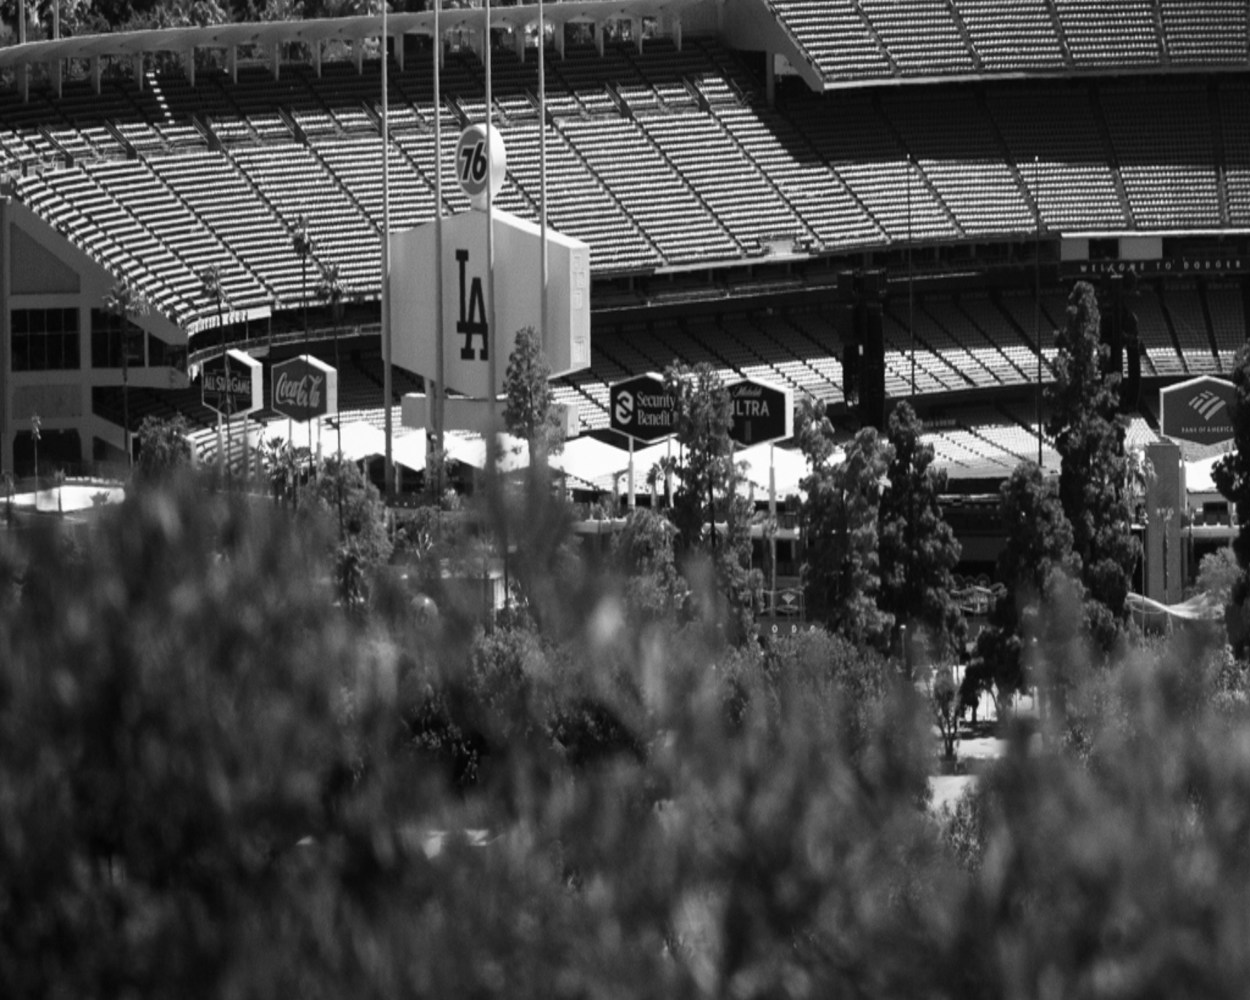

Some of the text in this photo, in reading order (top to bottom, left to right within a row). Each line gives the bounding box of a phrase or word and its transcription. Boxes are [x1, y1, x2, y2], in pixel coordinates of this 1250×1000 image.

[460, 140, 487, 184] 76
[456, 249, 488, 360] LA
[637, 392, 675, 411] Security
[637, 409, 670, 425] Benefit
